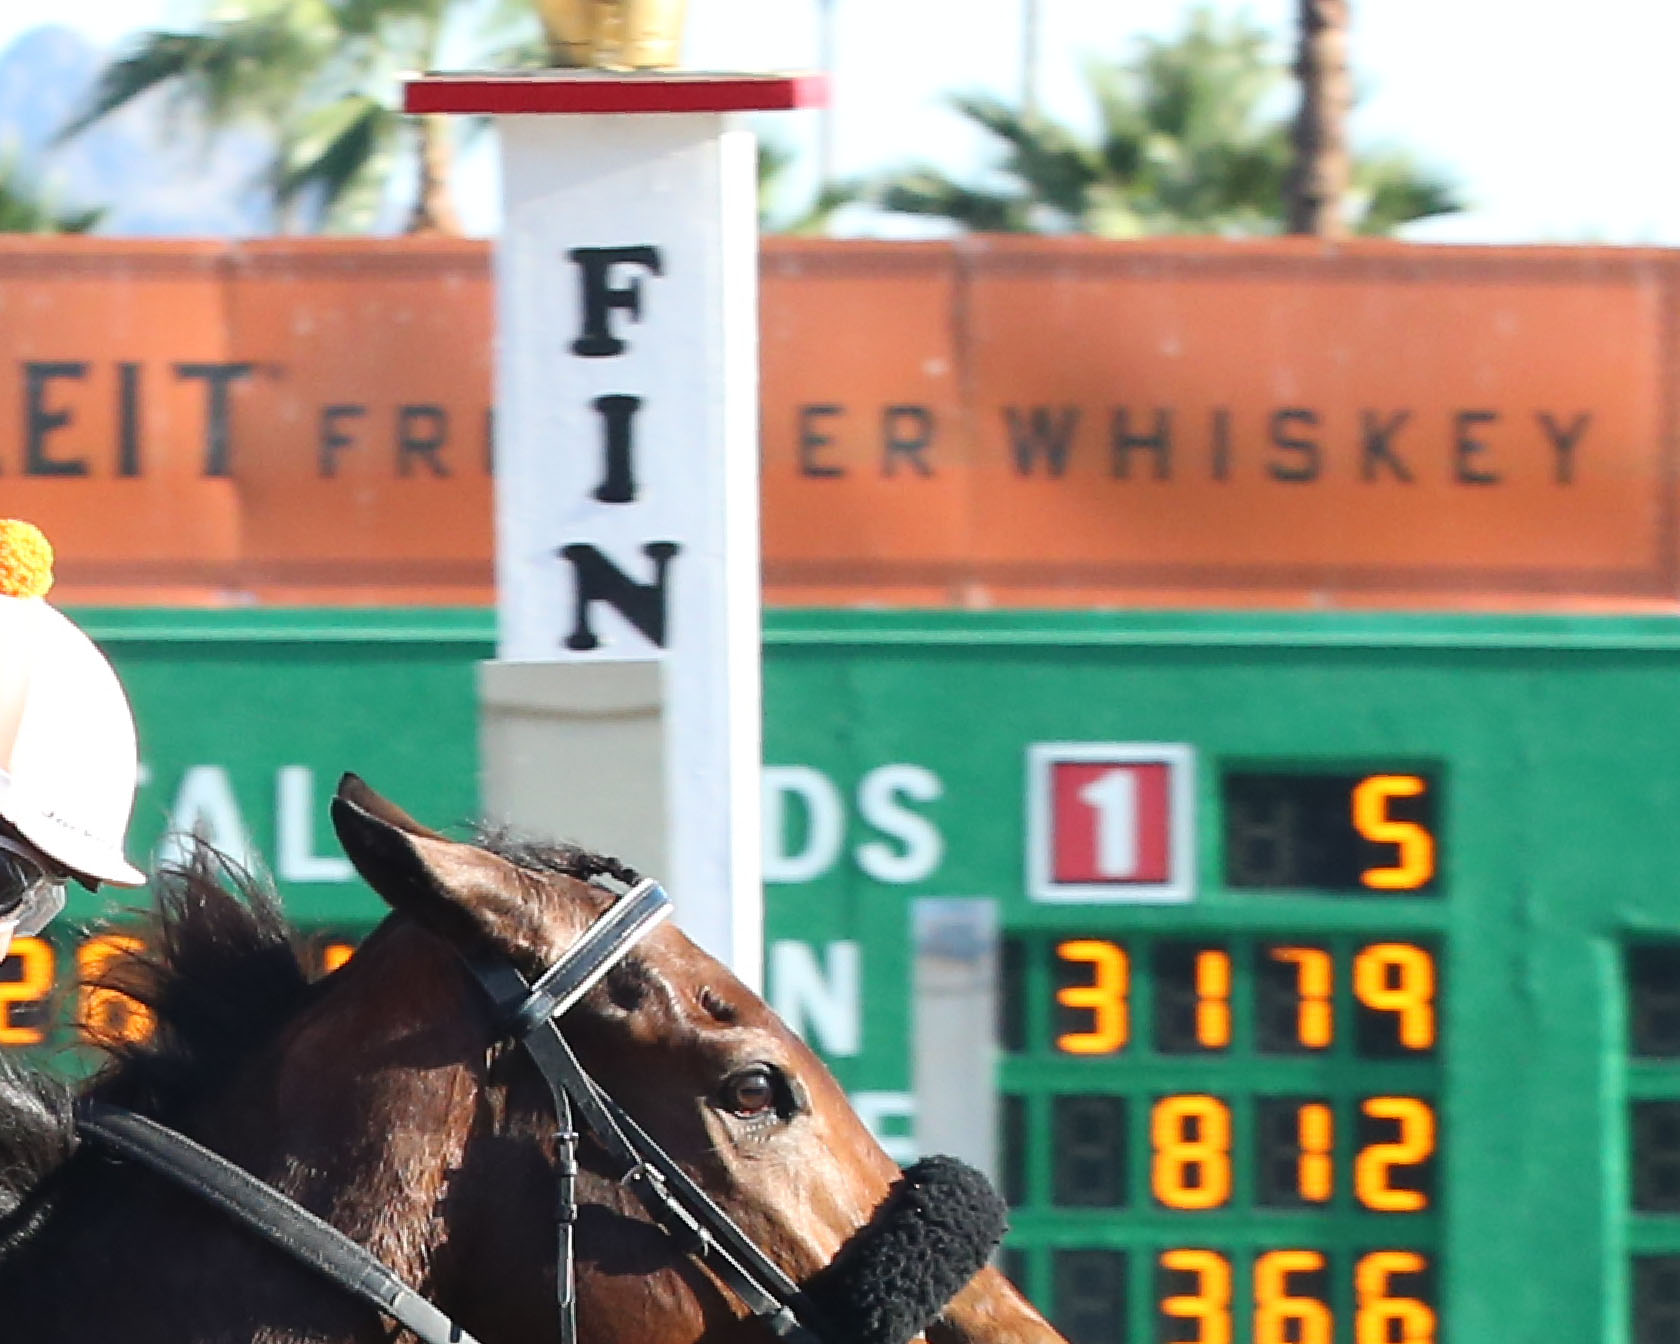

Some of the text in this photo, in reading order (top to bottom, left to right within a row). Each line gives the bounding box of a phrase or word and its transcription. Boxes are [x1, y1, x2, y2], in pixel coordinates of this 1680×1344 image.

[1001, 404, 1592, 486] WHISKEY
[1078, 768, 1138, 878] 1
[1352, 774, 1435, 890] 5
[1056, 939, 1435, 1055] 3179
[1150, 1094, 1435, 1212] 812
